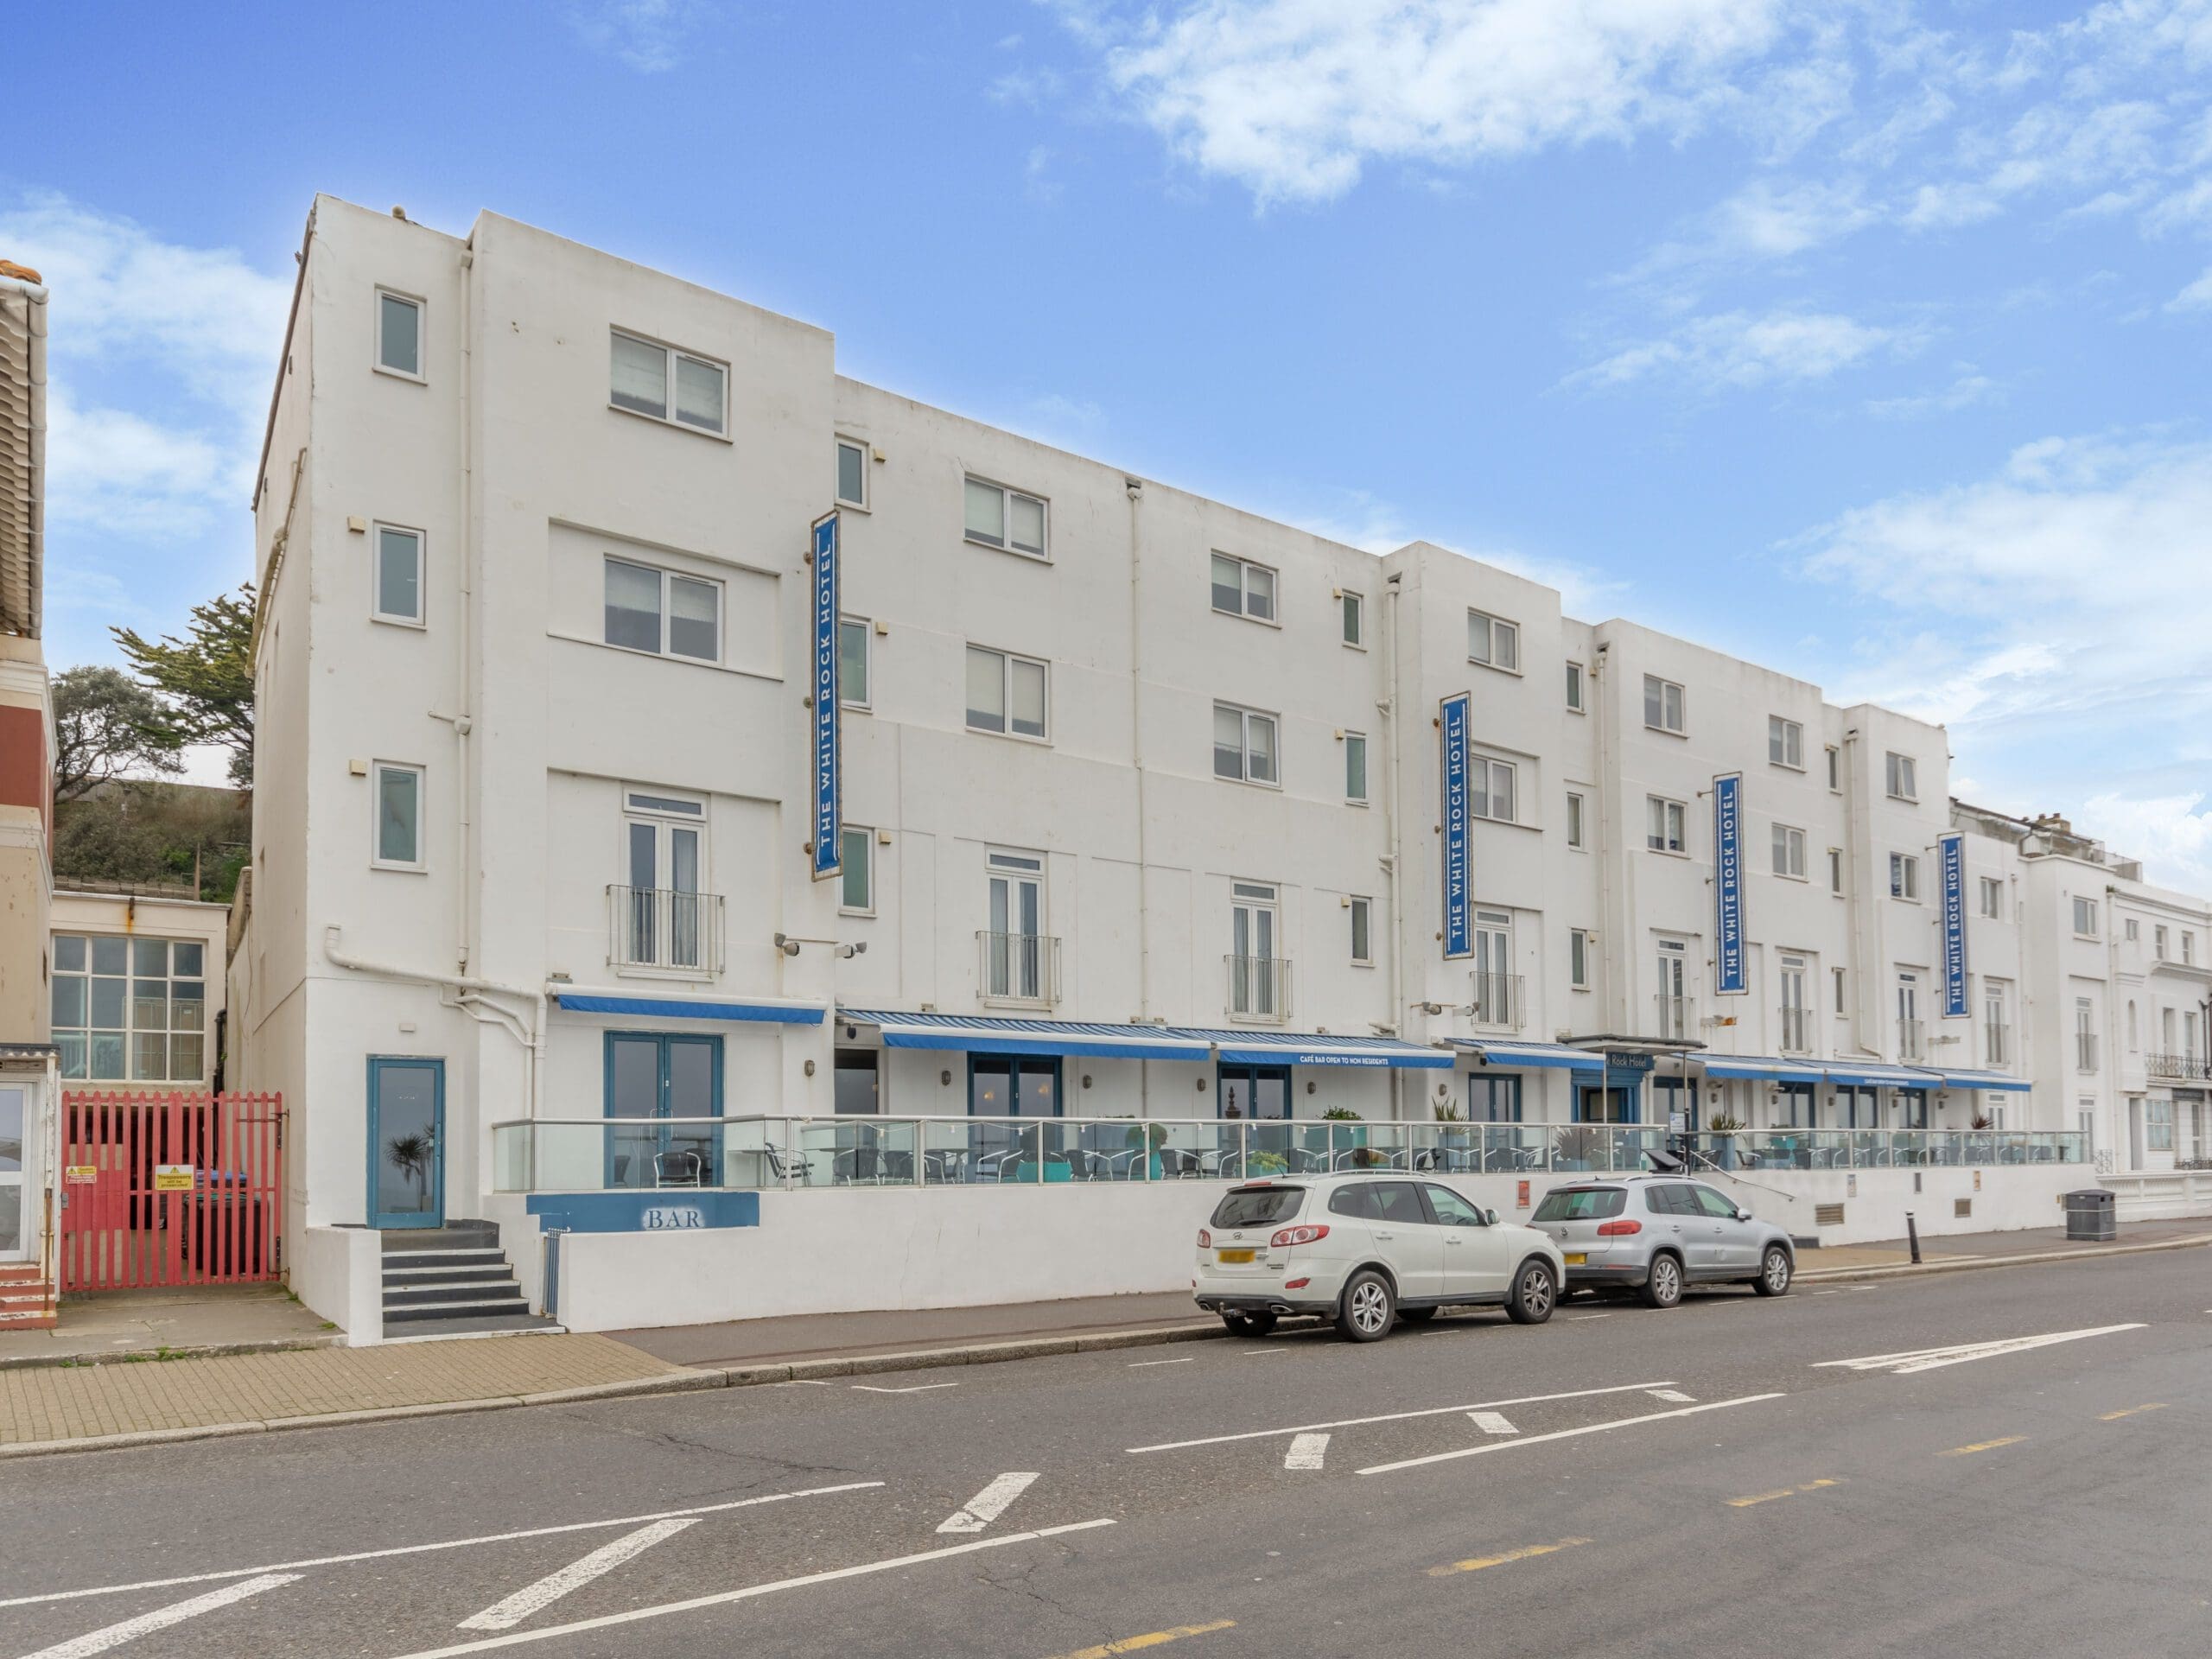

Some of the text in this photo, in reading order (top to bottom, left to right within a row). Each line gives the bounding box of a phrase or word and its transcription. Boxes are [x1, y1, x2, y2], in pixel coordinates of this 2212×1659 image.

[821, 543, 831, 847] THE WHITE ROCK HOTEL
[1450, 716, 1462, 938] THE WHITE ROCK HOTEL
[1723, 791, 1738, 977] THE WHITE ROCK HOTEL
[1947, 849, 1962, 1004] THE WHITE ROCK HOTEL
[1300, 1054, 1314, 1064] CAFÉ
[1611, 1054, 1628, 1066] Rock
[647, 1210, 700, 1229] BAR
